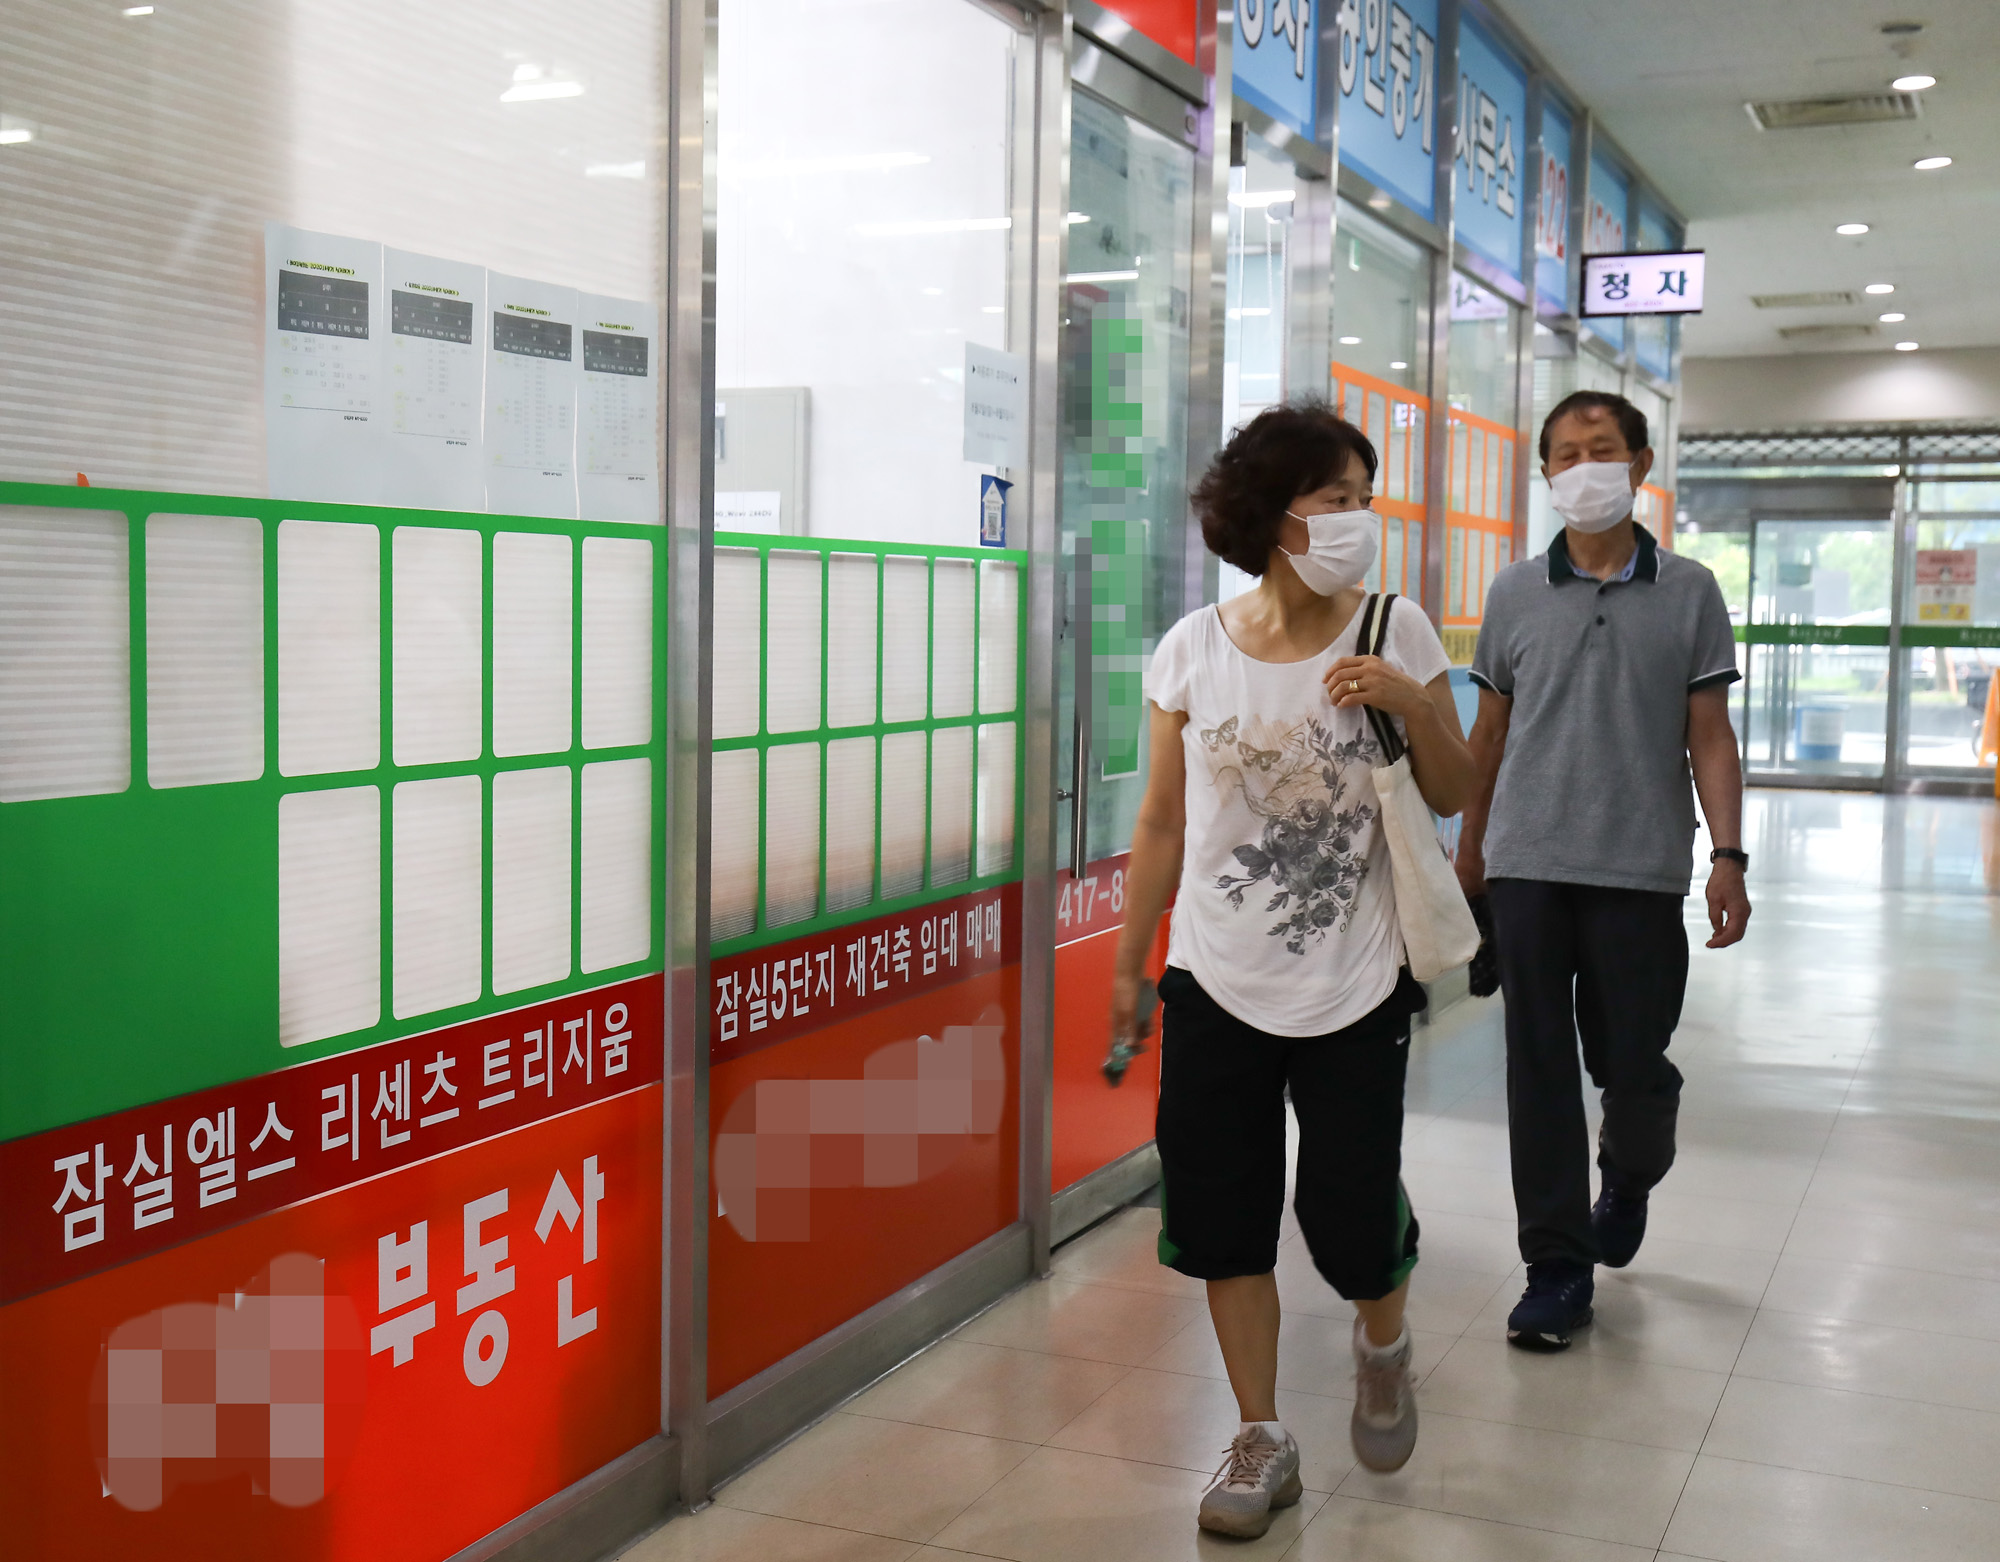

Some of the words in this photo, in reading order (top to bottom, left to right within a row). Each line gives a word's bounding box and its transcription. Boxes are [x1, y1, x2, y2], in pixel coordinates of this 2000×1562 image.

[715, 944, 835, 1042] 잠실5단지
[846, 925, 911, 996] 재건축
[920, 910, 958, 975] 임대
[966, 898, 1001, 958] 매매
[1058, 867, 1131, 927] 417-8
[52, 1101, 296, 1252] 잠실엘스
[321, 1051, 460, 1161] 리센츠
[478, 1002, 632, 1110] 트리지움
[370, 1154, 605, 1387] 부동산
